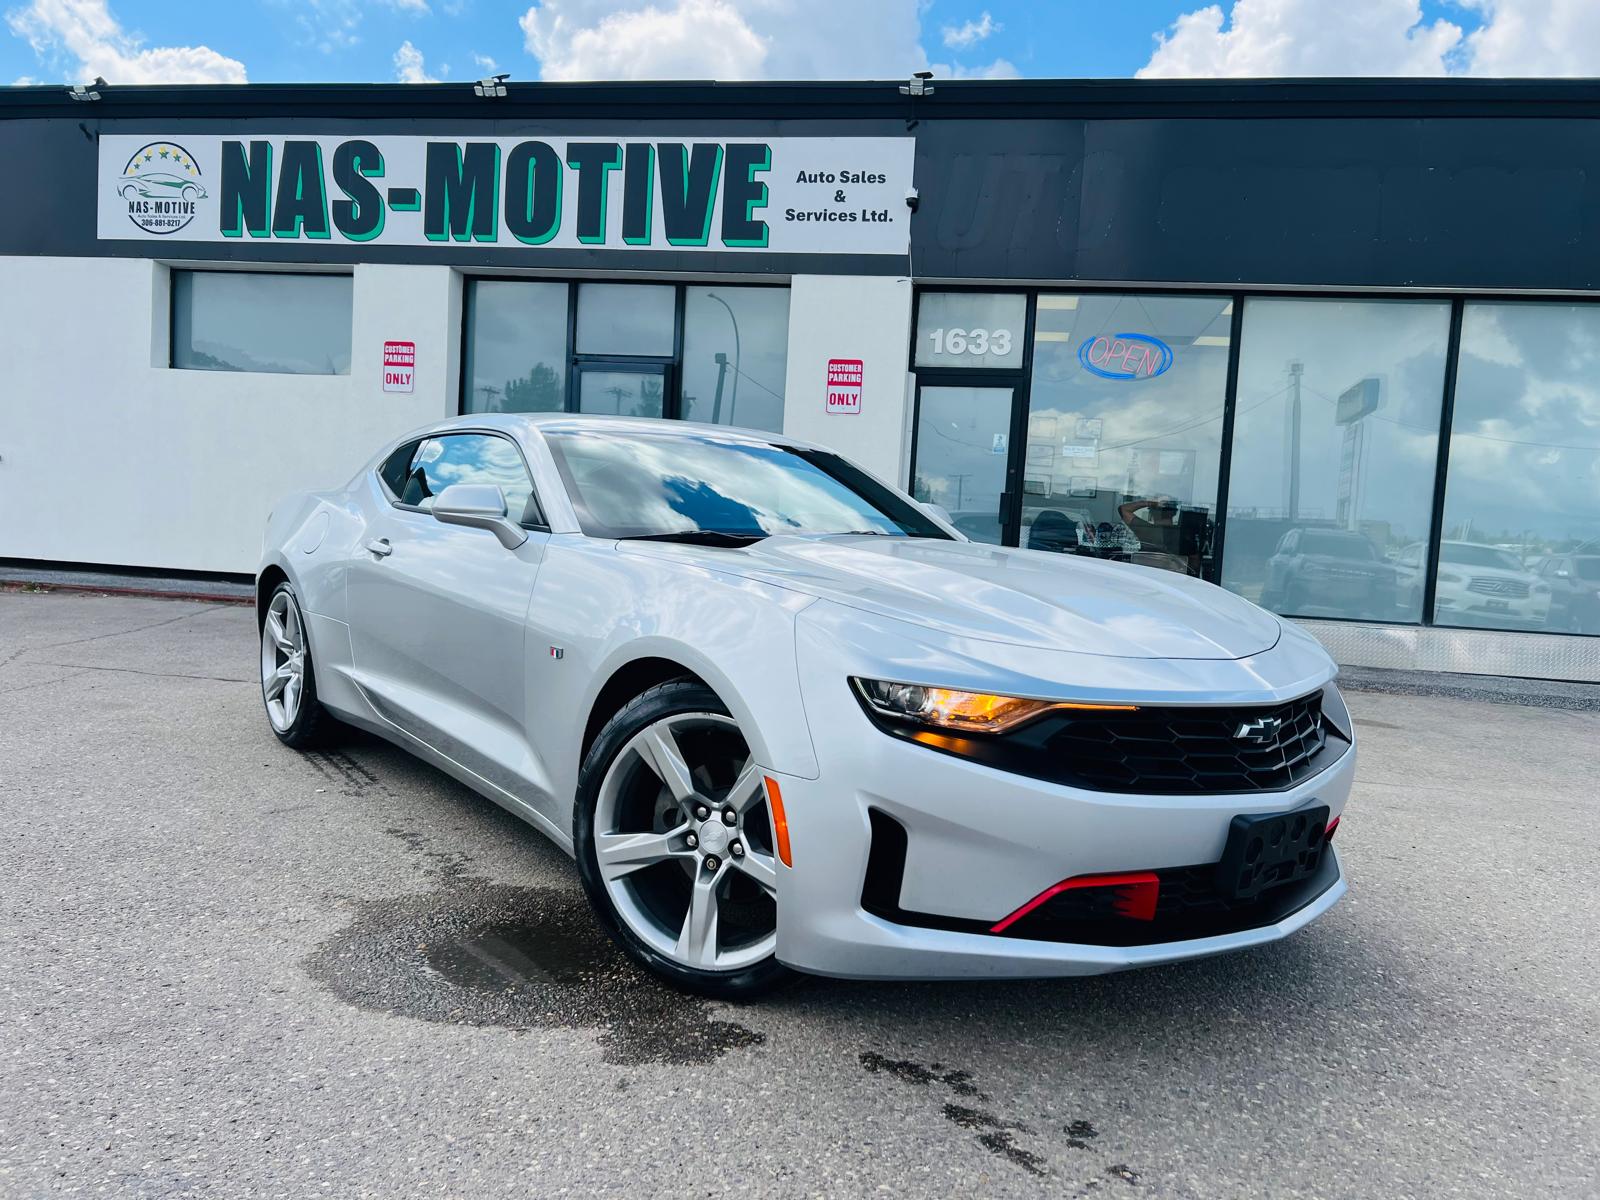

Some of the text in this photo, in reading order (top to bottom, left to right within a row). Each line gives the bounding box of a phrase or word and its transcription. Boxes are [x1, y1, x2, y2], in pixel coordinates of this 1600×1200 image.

[796, 170, 887, 184] Auto Sales
[220, 140, 772, 248] NAS-MOTIVE
[833, 189, 846, 203] &
[128, 201, 195, 214] NAS-MOTIVE
[785, 208, 894, 222] Services Ltd.
[141, 218, 181, 227] 306-881-8217
[929, 328, 1012, 356] 1633
[384, 354, 414, 363] PARKING
[1088, 336, 1160, 377] OPEN
[829, 364, 862, 373] CUSTOMER
[385, 373, 411, 385] ONLY
[828, 373, 861, 383] PARKING
[829, 393, 858, 406] ONLY
